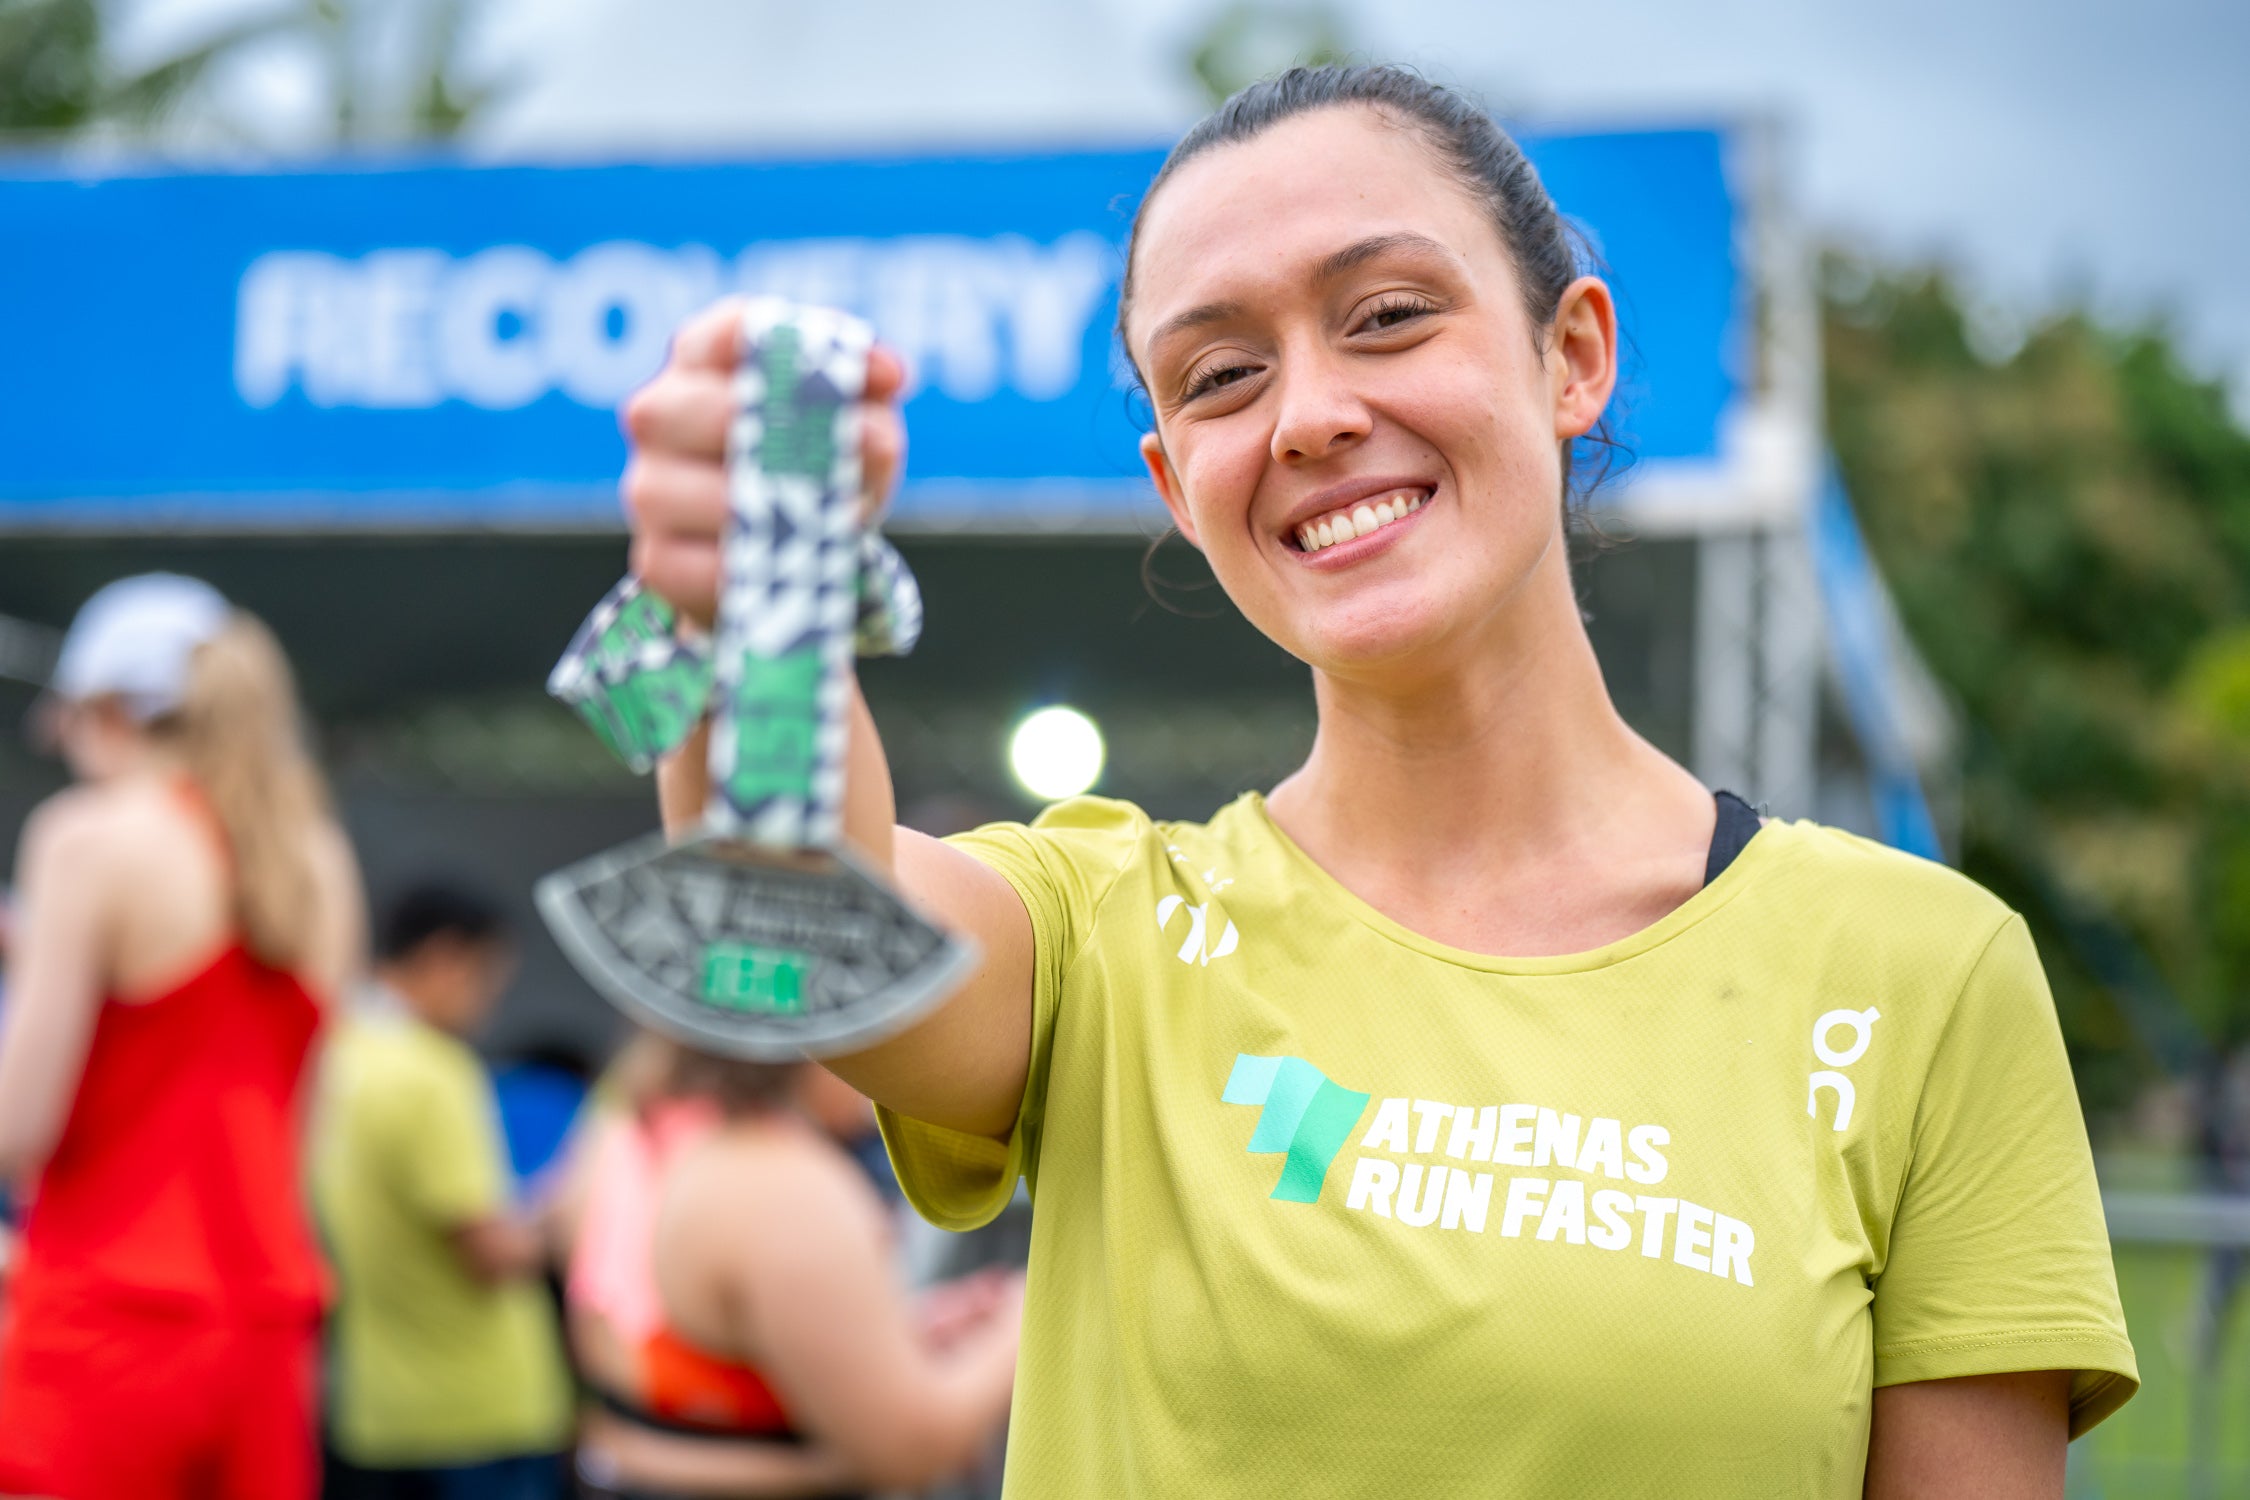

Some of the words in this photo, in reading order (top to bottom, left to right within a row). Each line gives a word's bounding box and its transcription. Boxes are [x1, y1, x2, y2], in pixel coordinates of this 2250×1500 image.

[1360, 1098, 1670, 1184] ATHENAS
[1346, 1157, 1494, 1233] RUN
[1501, 1178, 1754, 1287] FASTER
